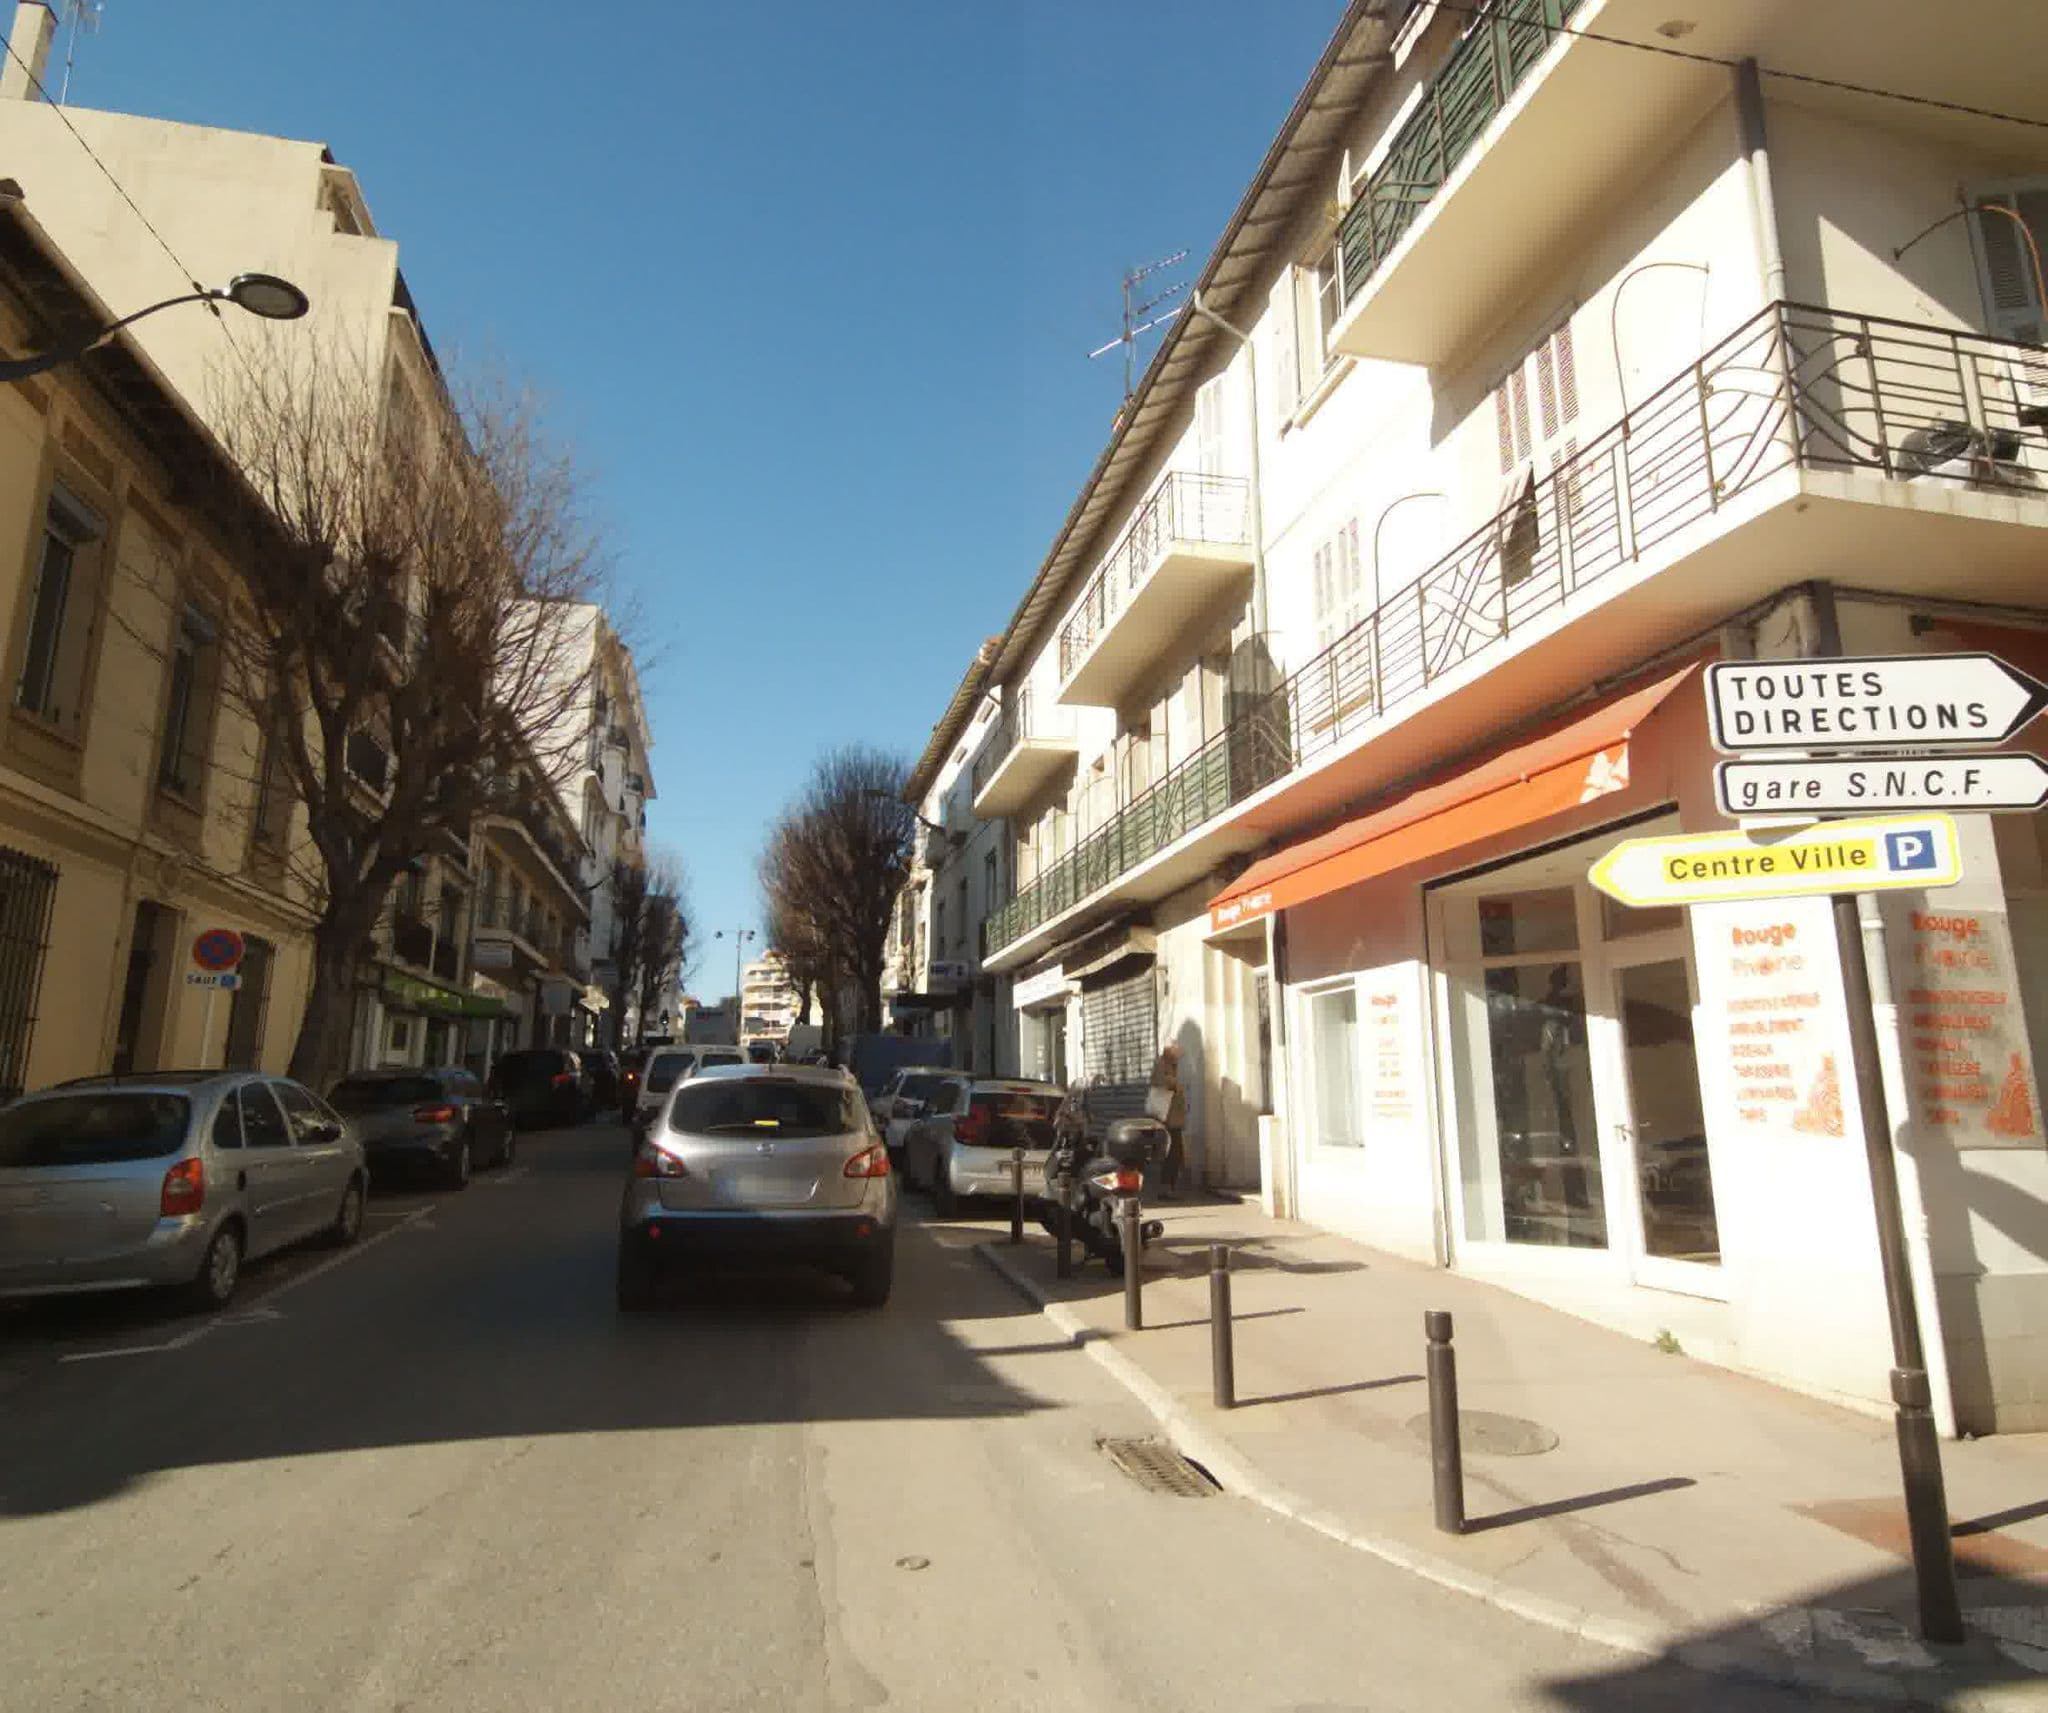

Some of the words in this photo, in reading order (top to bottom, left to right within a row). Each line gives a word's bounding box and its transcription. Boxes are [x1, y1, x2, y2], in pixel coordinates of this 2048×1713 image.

[1730, 672, 1883, 701] TOUTES
[1735, 702, 1988, 735] DIRECTIONS
[1742, 778, 1822, 807] gare
[1847, 769, 1993, 798] S.N.C.F.
[1669, 855, 1775, 881] Centre
[1790, 845, 1867, 870] Ville
